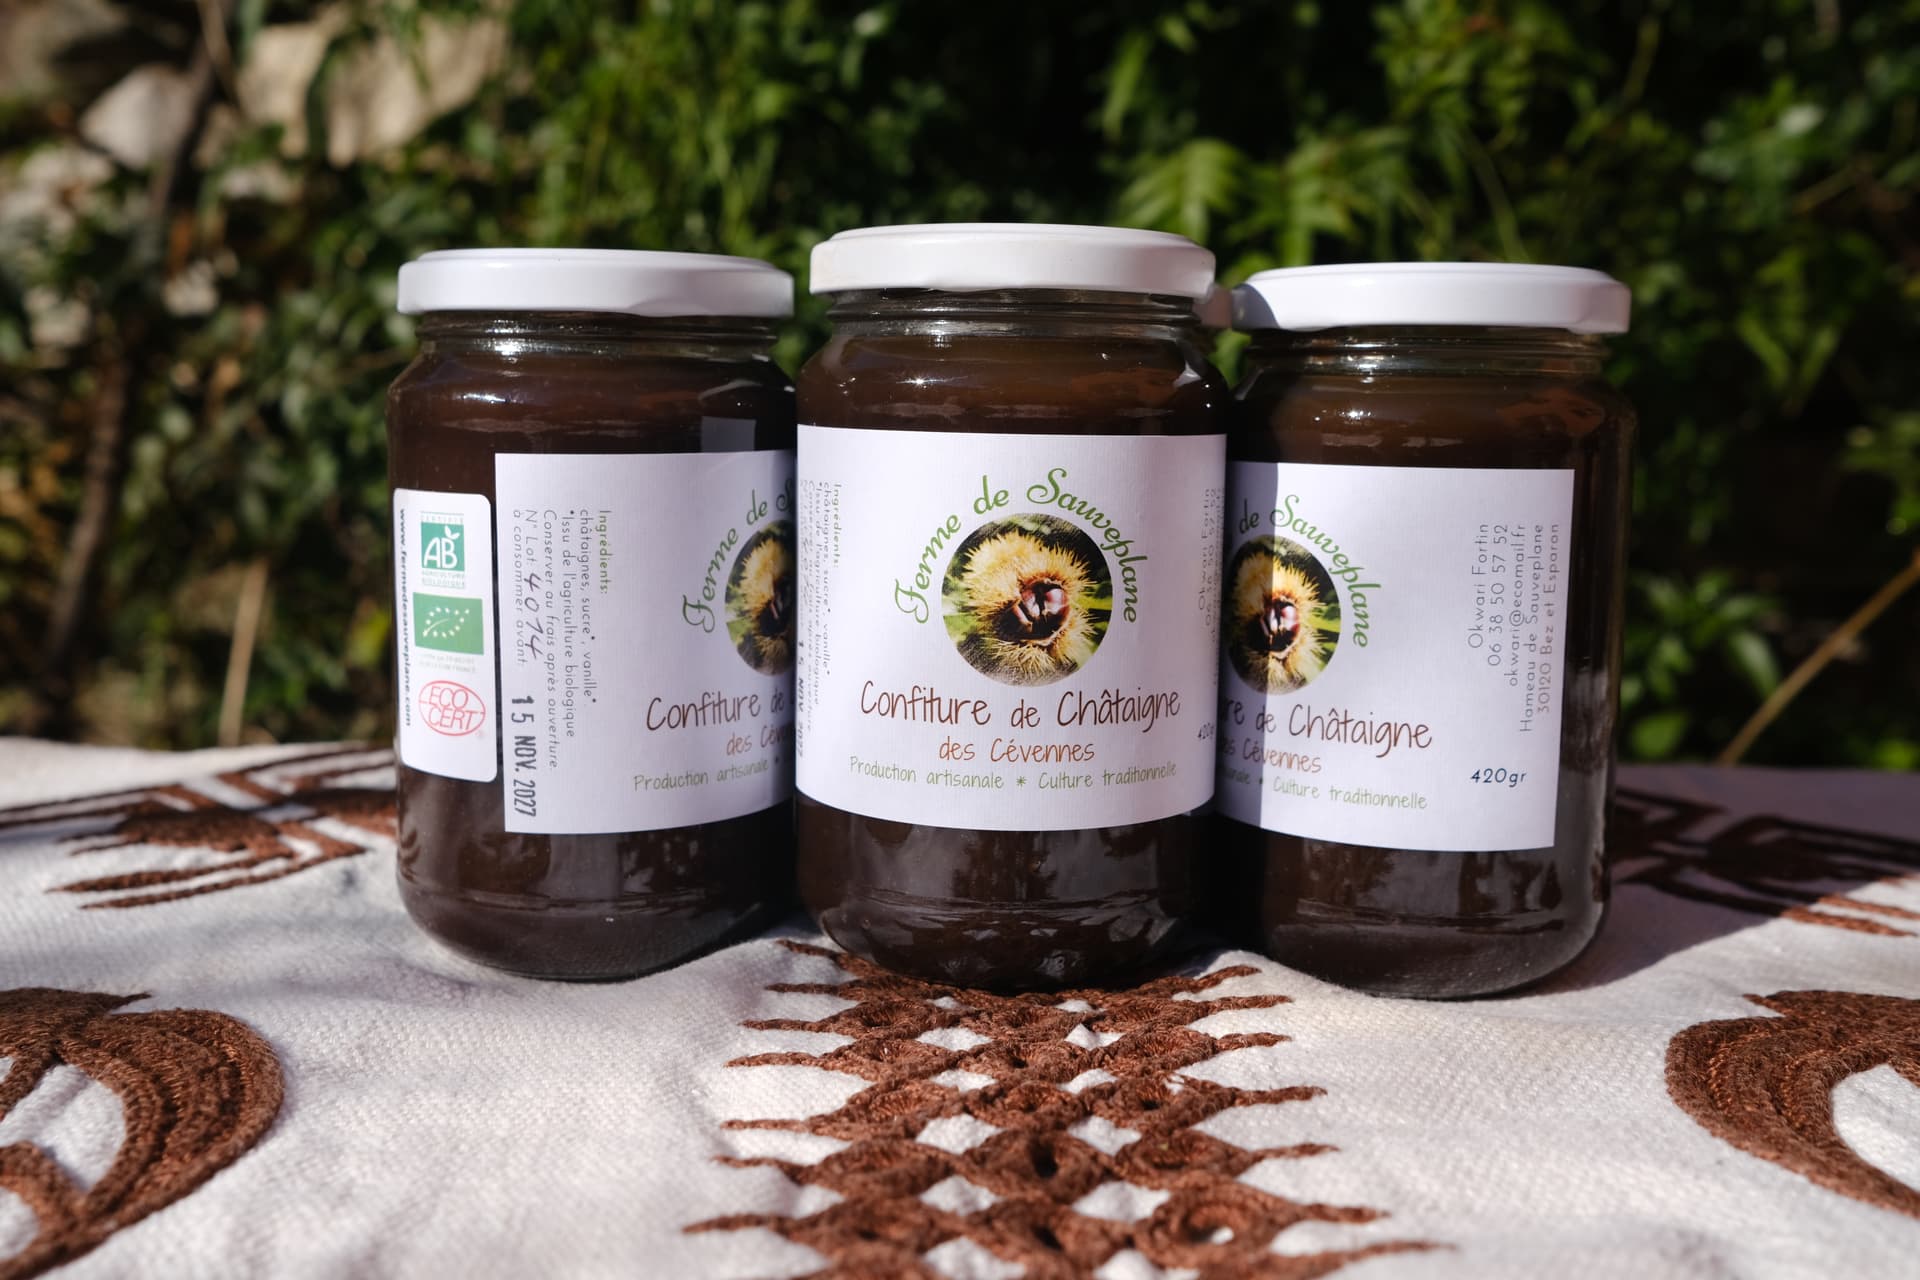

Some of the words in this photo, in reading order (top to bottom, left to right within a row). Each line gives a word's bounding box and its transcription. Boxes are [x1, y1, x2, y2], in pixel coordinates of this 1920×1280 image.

[746, 488, 768, 526] de
[544, 509, 558, 585] Conserver
[973, 475, 1009, 515] de
[1026, 467, 1149, 624] Sauveplane
[1471, 524, 1489, 575] Fortin
[1493, 525, 1508, 545] 52
[423, 536, 459, 569] AB
[562, 550, 577, 567] de
[1491, 554, 1506, 573] 57
[1543, 524, 1561, 593] Esparon
[1239, 498, 1260, 534] de
[1269, 494, 1382, 648] Sauveplane
[1524, 525, 1545, 625] Sauveplane
[545, 591, 554, 609] au
[1490, 582, 1505, 605] 50
[1543, 603, 1555, 617] et
[546, 615, 561, 647] frais
[560, 573, 578, 658] l'agriculture
[1467, 584, 1486, 648] Okwari
[1489, 614, 1504, 633] 38
[1487, 643, 1502, 666] 06
[1522, 633, 1537, 653] de
[1540, 625, 1554, 655] Bez
[428, 685, 469, 709] ECO
[562, 665, 579, 737] biologique
[1519, 661, 1536, 732] Hameau
[1537, 662, 1552, 713] 30120
[428, 706, 478, 730] CERT
[646, 691, 761, 731] Confiture
[861, 680, 991, 725] Confiture
[1011, 698, 1041, 729] de
[1057, 687, 1181, 733] Châtaigne
[726, 732, 753, 756] des
[1256, 704, 1277, 733] de
[1289, 703, 1432, 759] Châtaigne
[939, 735, 976, 761] des
[990, 737, 1095, 763] Cévennes
[1242, 738, 1322, 773] Cévennes
[633, 770, 709, 792] Production
[849, 755, 917, 783] Production
[926, 769, 1004, 789] artisanale
[1038, 771, 1093, 790] Culture
[1102, 761, 1177, 786] traditionnelle
[1470, 767, 1527, 788] 420gr
[513, 778, 537, 818] 2027
[1272, 776, 1320, 799] Culture
[1329, 785, 1428, 809] traditionnelle
